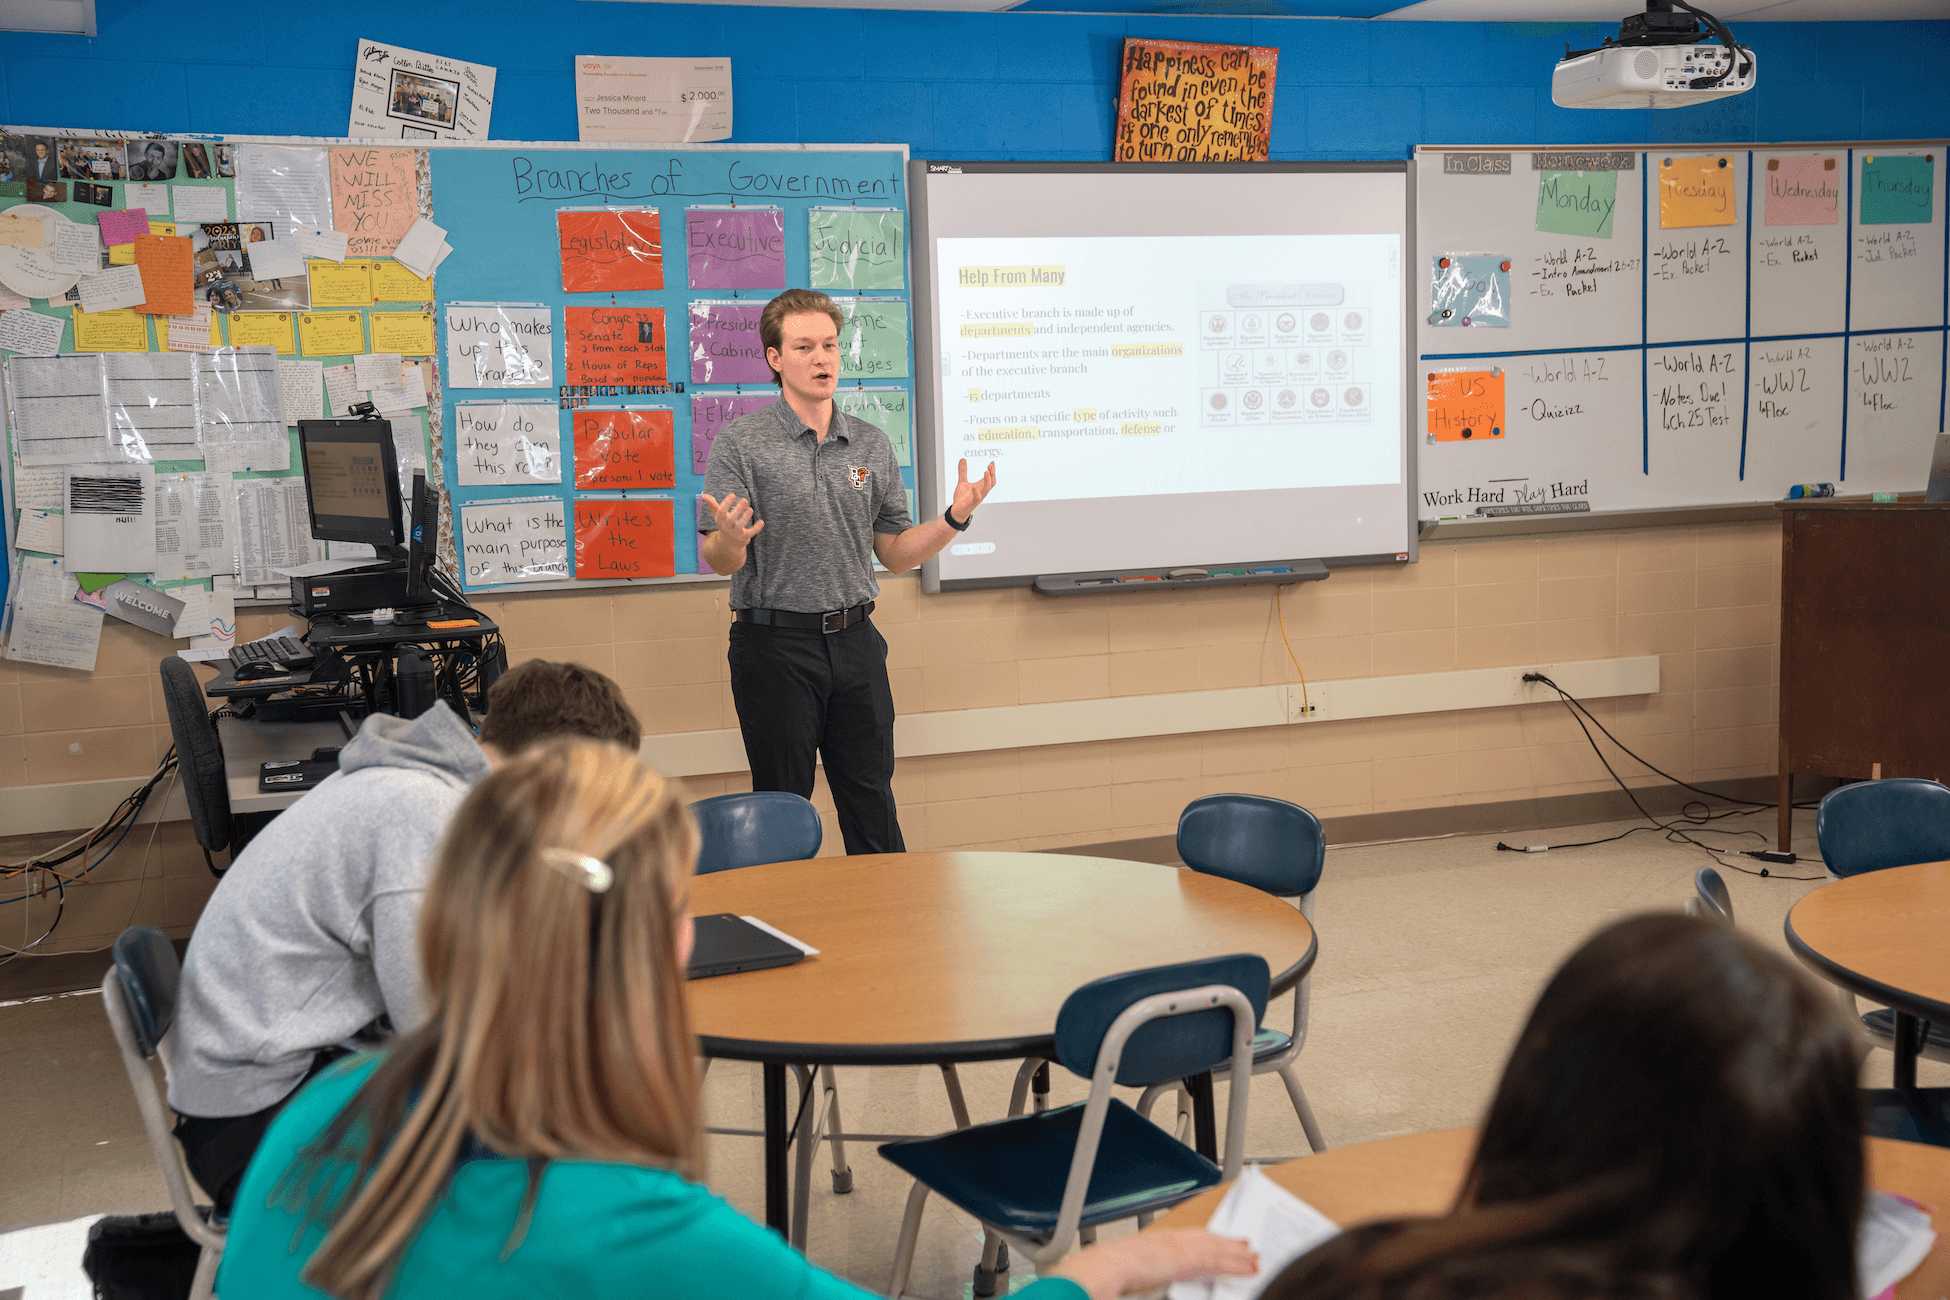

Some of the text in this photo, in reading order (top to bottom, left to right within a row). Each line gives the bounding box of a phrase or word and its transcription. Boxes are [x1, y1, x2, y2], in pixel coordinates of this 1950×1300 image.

[1126, 46, 1250, 80] Happiness can
[1249, 62, 1266, 89] be
[1130, 74, 1237, 102] found in even
[1241, 83, 1266, 111] the
[1131, 98, 1266, 134] darkest of times,
[1120, 118, 1135, 143] if
[1139, 123, 1169, 142] one
[1176, 119, 1212, 147] only
[339, 150, 379, 167] WE
[1120, 139, 1219, 161] to turn on the
[1446, 156, 1510, 172] In Class
[1535, 153, 1629, 169] Homework
[343, 171, 395, 187] WILL
[512, 157, 900, 196] Branches of Government
[1664, 177, 1727, 212] Tuesday
[1770, 174, 1839, 211] Wednesday
[1865, 170, 1930, 207] Thursday
[344, 189, 393, 211] MISS
[1542, 178, 1615, 233] Monday
[353, 211, 388, 231] YOU
[560, 229, 660, 258] Legislative
[689, 221, 782, 254] Executive
[812, 226, 898, 258] Judicial
[1792, 250, 1818, 263] Packet
[959, 267, 1065, 287] Help From Many
[1682, 260, 1710, 276] Packet
[1566, 278, 1597, 297] Packet
[592, 309, 649, 331] Congress
[961, 306, 1134, 321] -Executive branch is made up of
[450, 316, 501, 334] Who
[510, 317, 552, 336] makes
[579, 330, 623, 342] Senate
[961, 322, 1175, 338] departments and independent agencies.
[459, 344, 482, 361] up
[592, 344, 614, 352] from
[961, 345, 1183, 362] -Departments are the main organizations
[583, 360, 658, 371] House of Reps
[961, 363, 1087, 377] of the executive branch
[581, 374, 607, 384] Based
[1460, 377, 1486, 397] US
[981, 389, 1050, 402] departments
[1700, 381, 1727, 403] Due!
[459, 412, 534, 432] How do
[963, 407, 1177, 425] -Focus on a specific type of activity such
[1435, 408, 1496, 436] History
[1687, 409, 1704, 427] 25
[1705, 404, 1730, 426] Test
[584, 419, 654, 440] Popular
[963, 423, 1176, 442] as education, transportation, defense or
[464, 437, 498, 455] they
[964, 447, 1004, 458] energy.
[474, 456, 506, 475] this
[649, 470, 674, 483] vote
[1423, 479, 1588, 507] Work Hard play Hard
[466, 512, 565, 534] What is the
[578, 511, 652, 528] Writes
[466, 537, 567, 557] main purpose
[608, 531, 639, 550] the
[502, 560, 524, 574] this
[598, 553, 640, 572] Laws
[113, 590, 171, 619] WELCOME
